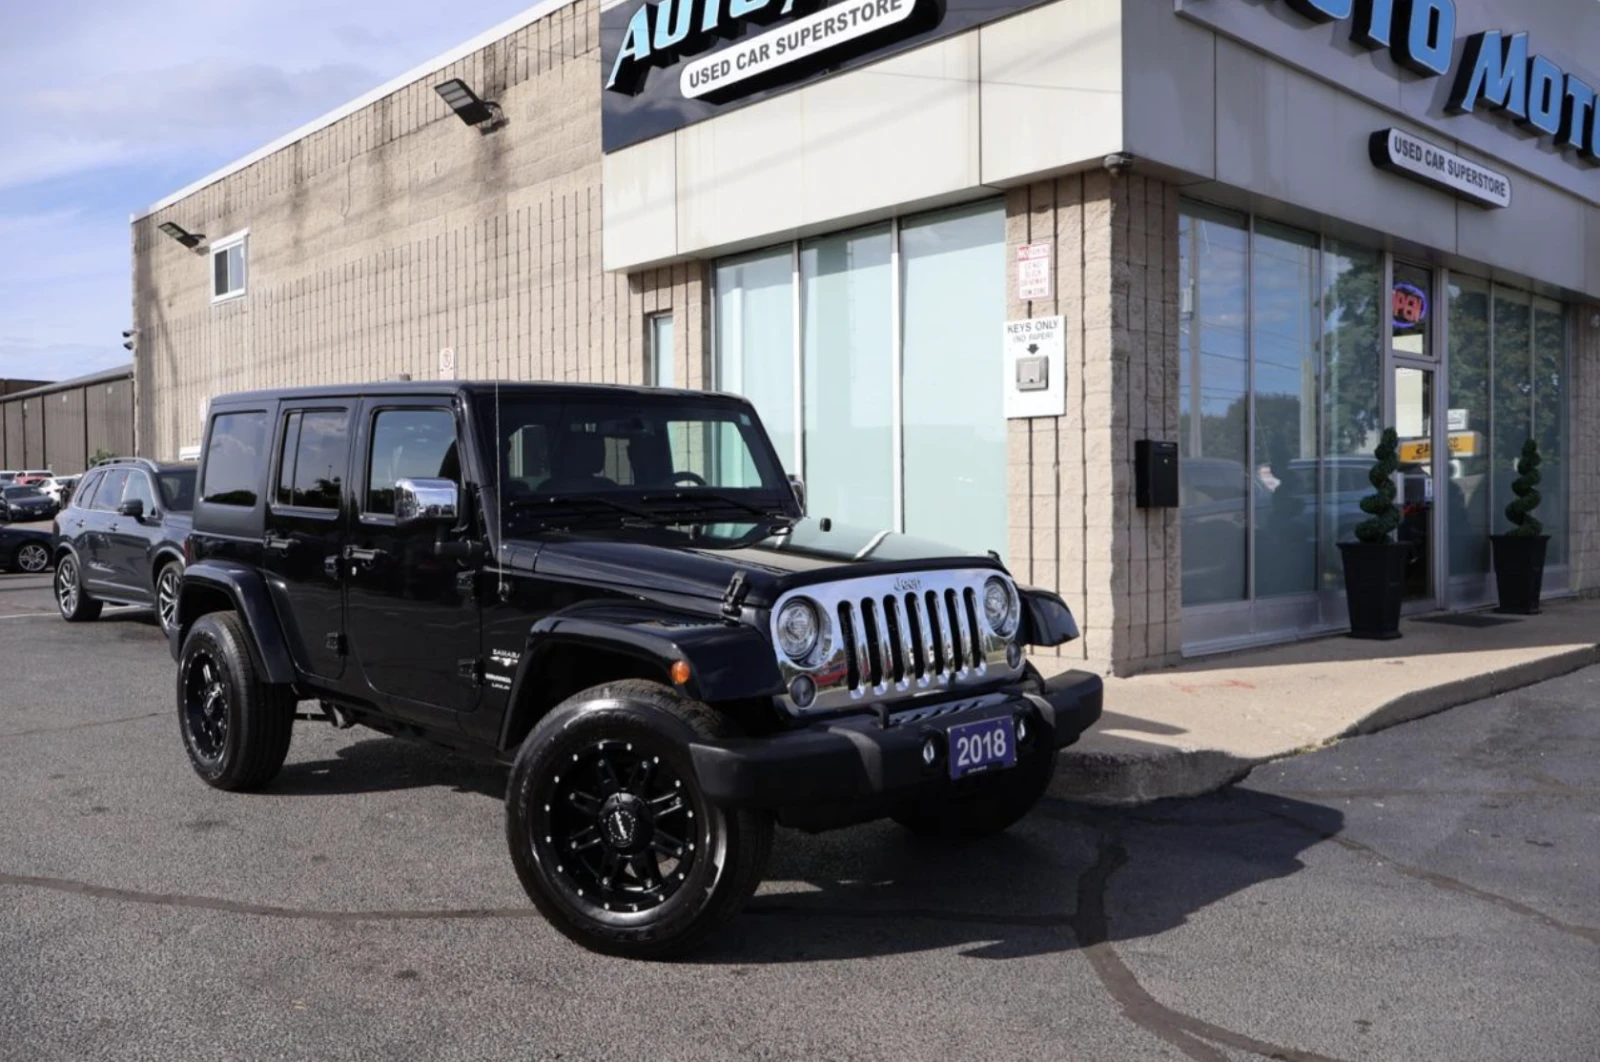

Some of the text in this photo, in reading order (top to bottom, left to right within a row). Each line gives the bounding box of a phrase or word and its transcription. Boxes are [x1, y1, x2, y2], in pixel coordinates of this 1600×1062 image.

[689, 59, 731, 88] USED
[736, 43, 770, 74] CAR
[776, 0, 903, 55] SUPERSTORE
[1394, 135, 1506, 198] USED CAR SUPERSTORE
[1392, 290, 1422, 322] PEN
[1007, 319, 1059, 334] KEYS ONLY
[957, 729, 1006, 767] 2018
